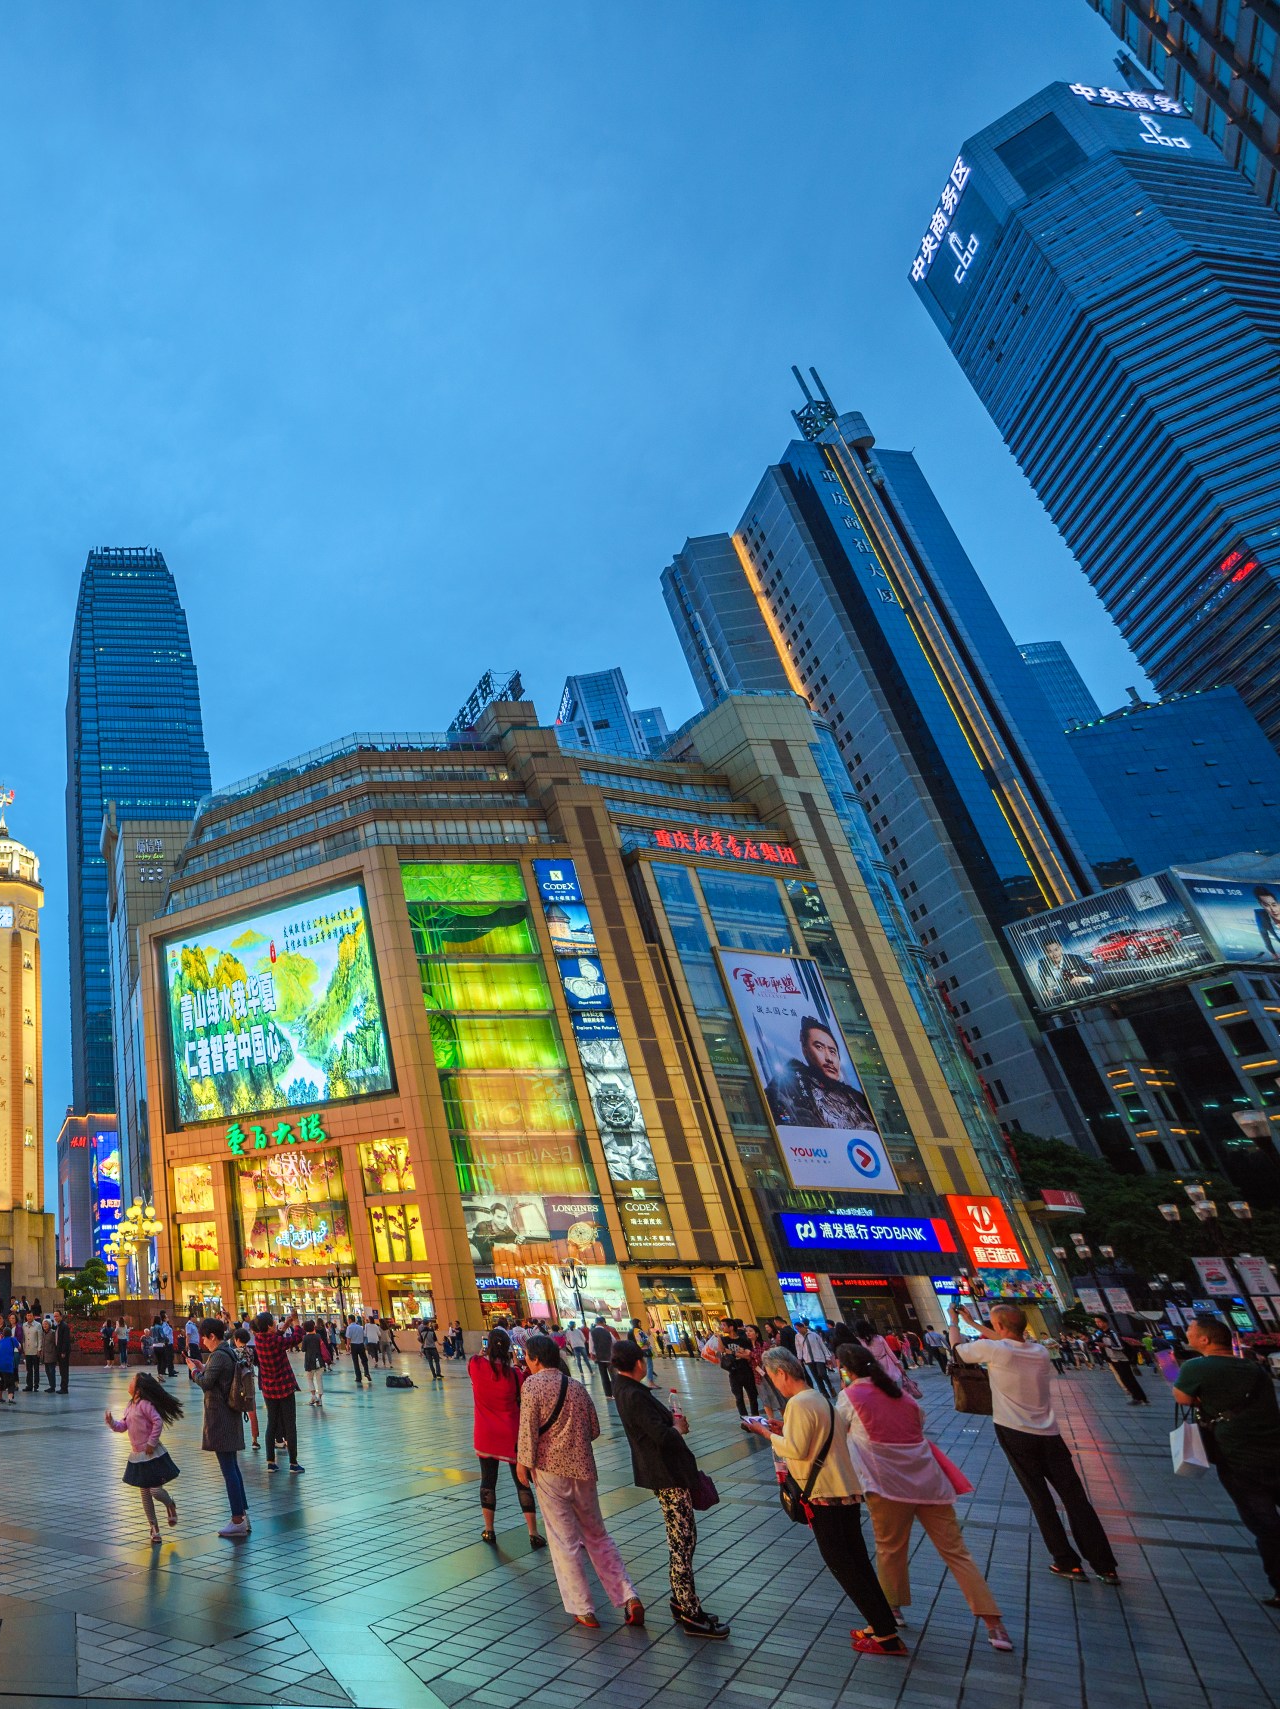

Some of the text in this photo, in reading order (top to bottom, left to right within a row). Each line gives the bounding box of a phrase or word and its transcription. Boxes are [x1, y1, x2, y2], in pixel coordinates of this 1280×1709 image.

[911, 156, 970, 282] 中央商务区
[821, 469, 897, 604] 重庆商社大厦
[1226, 888, 1243, 896] 308
[180, 970, 277, 1032] 青山绿水我华夏
[184, 1021, 281, 1080] 仁者智者中国心
[225, 1113, 326, 1155] 重百大楼
[790, 1147, 828, 1158] YOUKU
[552, 1204, 599, 1213] LONGINES
[819, 1222, 927, 1241] 浦发银行 SPD BANK
[979, 1235, 1003, 1244] CBEST
[973, 1247, 1021, 1264] 重百超市
